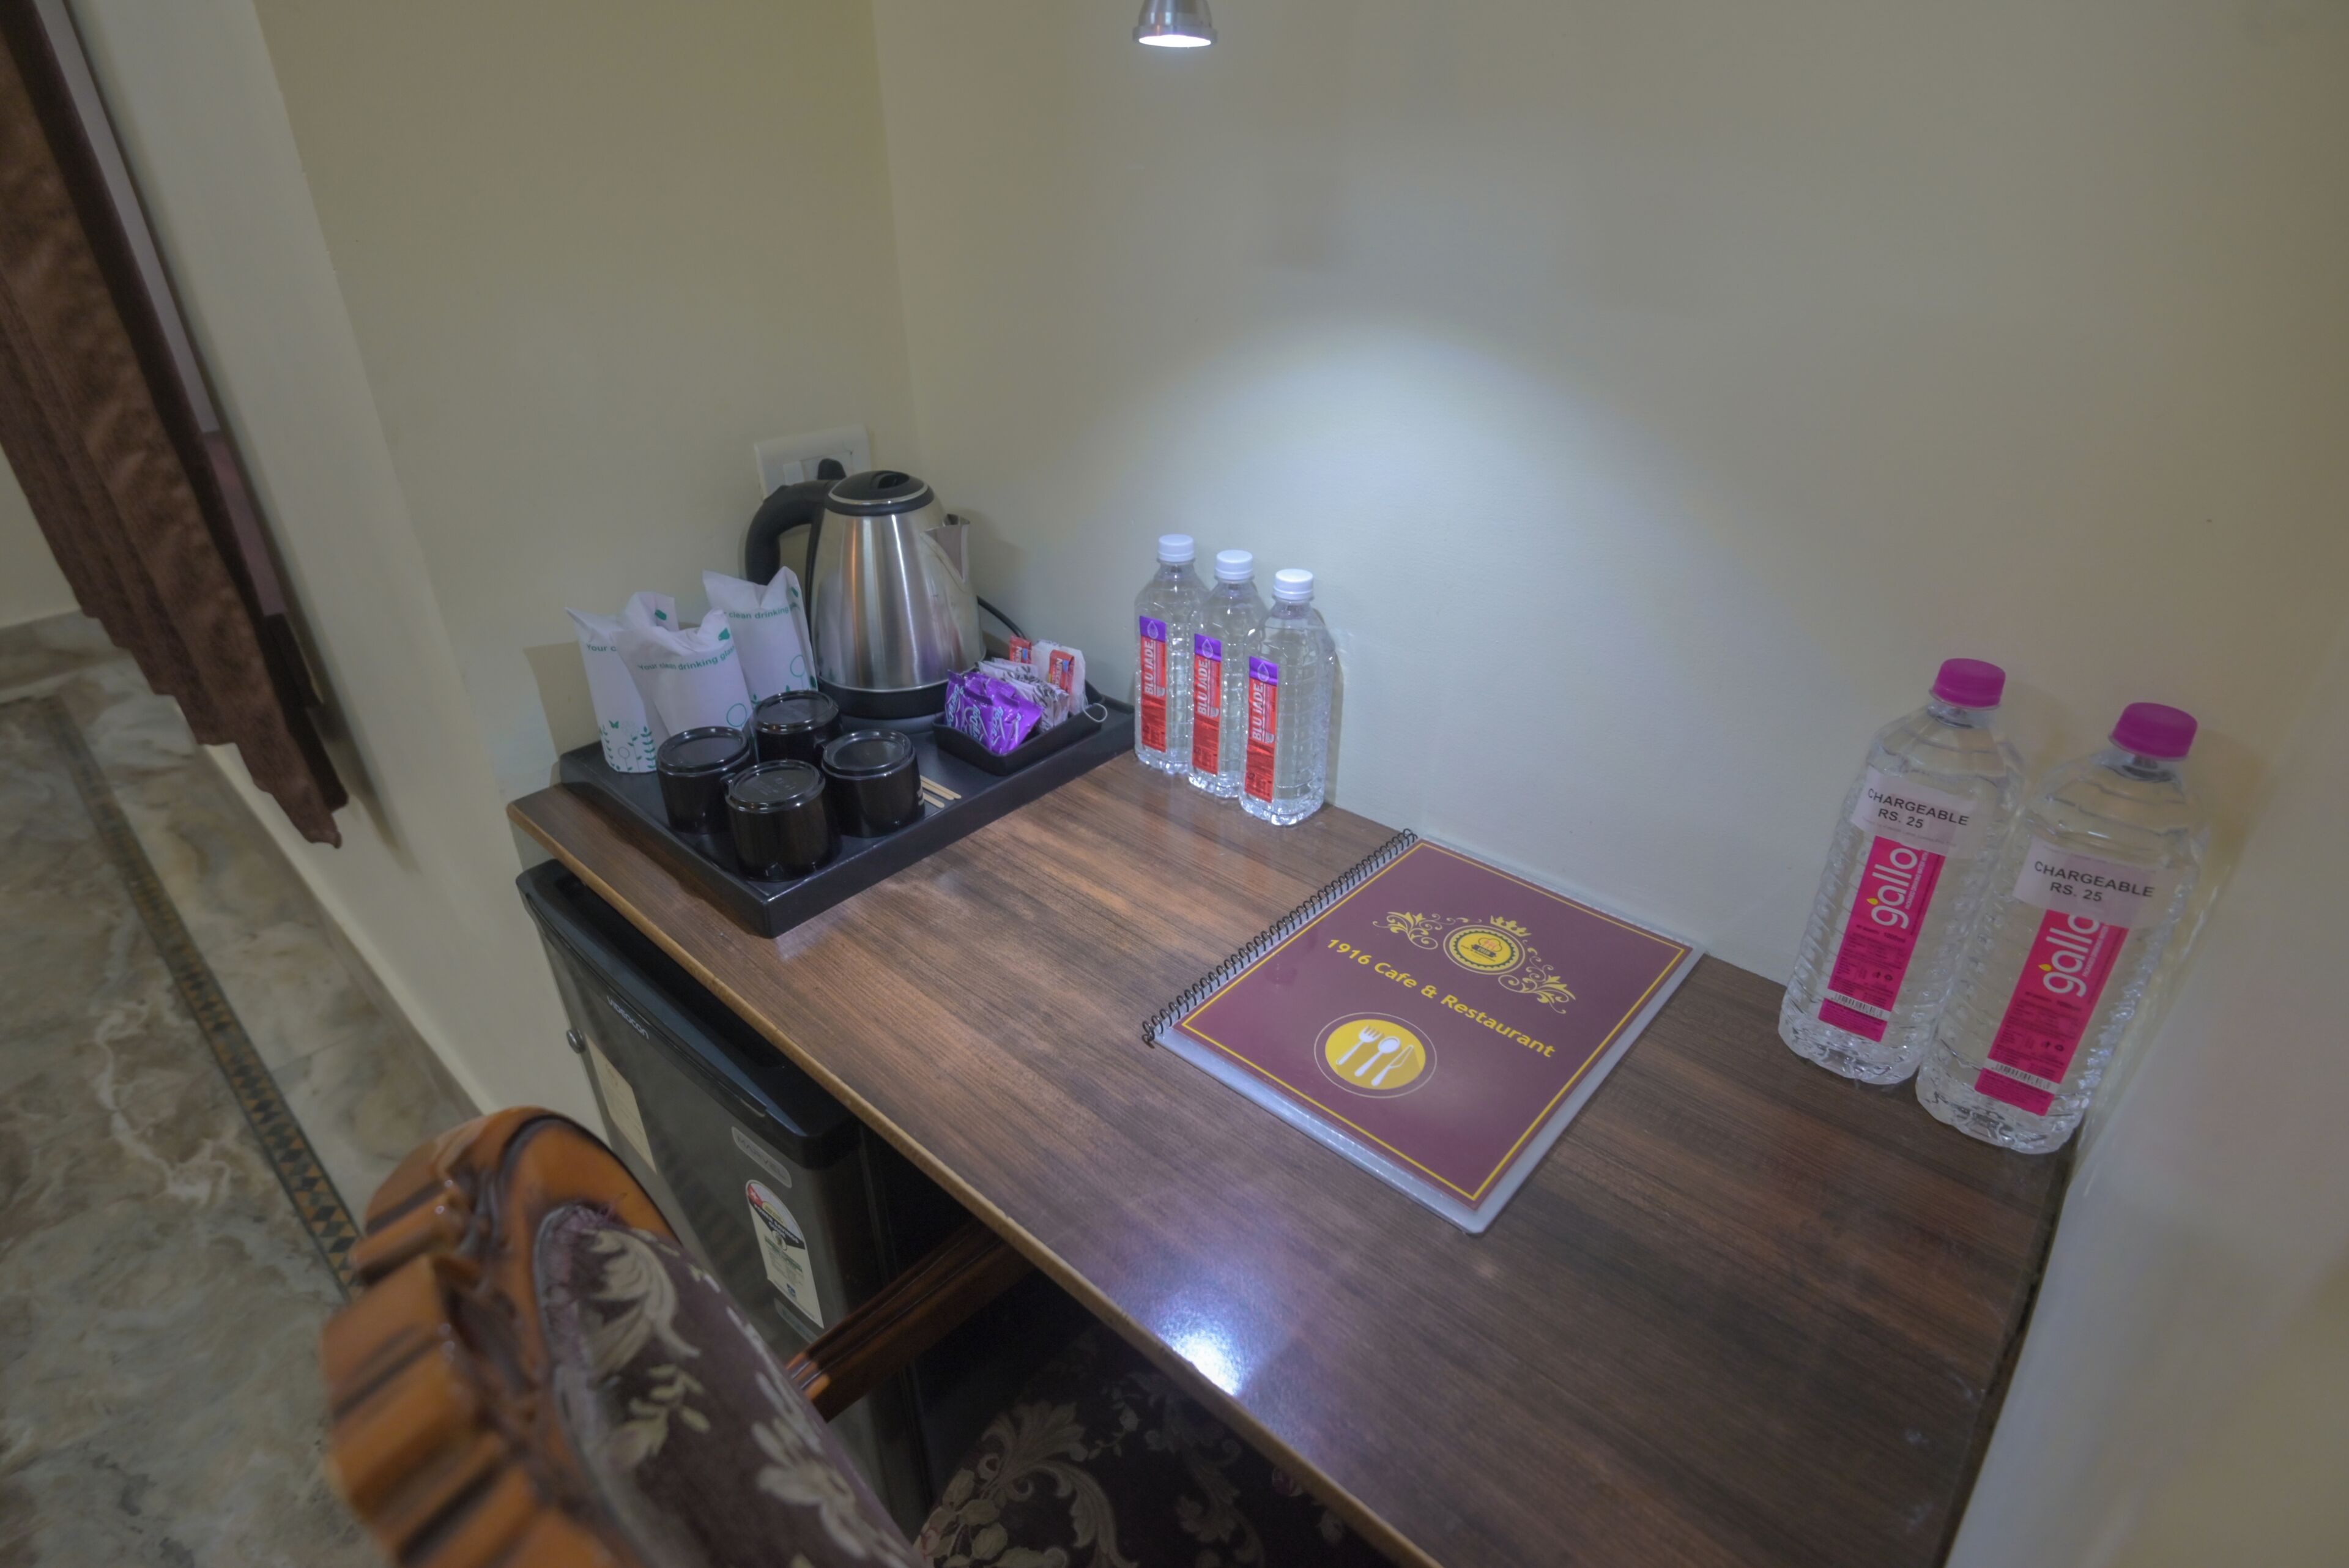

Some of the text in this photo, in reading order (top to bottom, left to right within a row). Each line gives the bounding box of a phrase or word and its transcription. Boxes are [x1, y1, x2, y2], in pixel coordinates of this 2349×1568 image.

[754, 605, 789, 620] drinking
[586, 644, 607, 652] Your
[678, 656, 719, 671] drinking
[1144, 672, 1154, 695] BLU
[1197, 692, 1208, 715] BLU
[1252, 717, 1263, 741] BLU
[1868, 788, 1970, 826] CHARGEABLE
[1877, 808, 1924, 828] RS. 25
[1871, 845, 1918, 929] gallo
[2034, 861, 2155, 897] CHARGEABLE
[2050, 882, 2103, 902] RS. 25
[1327, 938, 1557, 1058] 1916 Cafe & Restaurant
